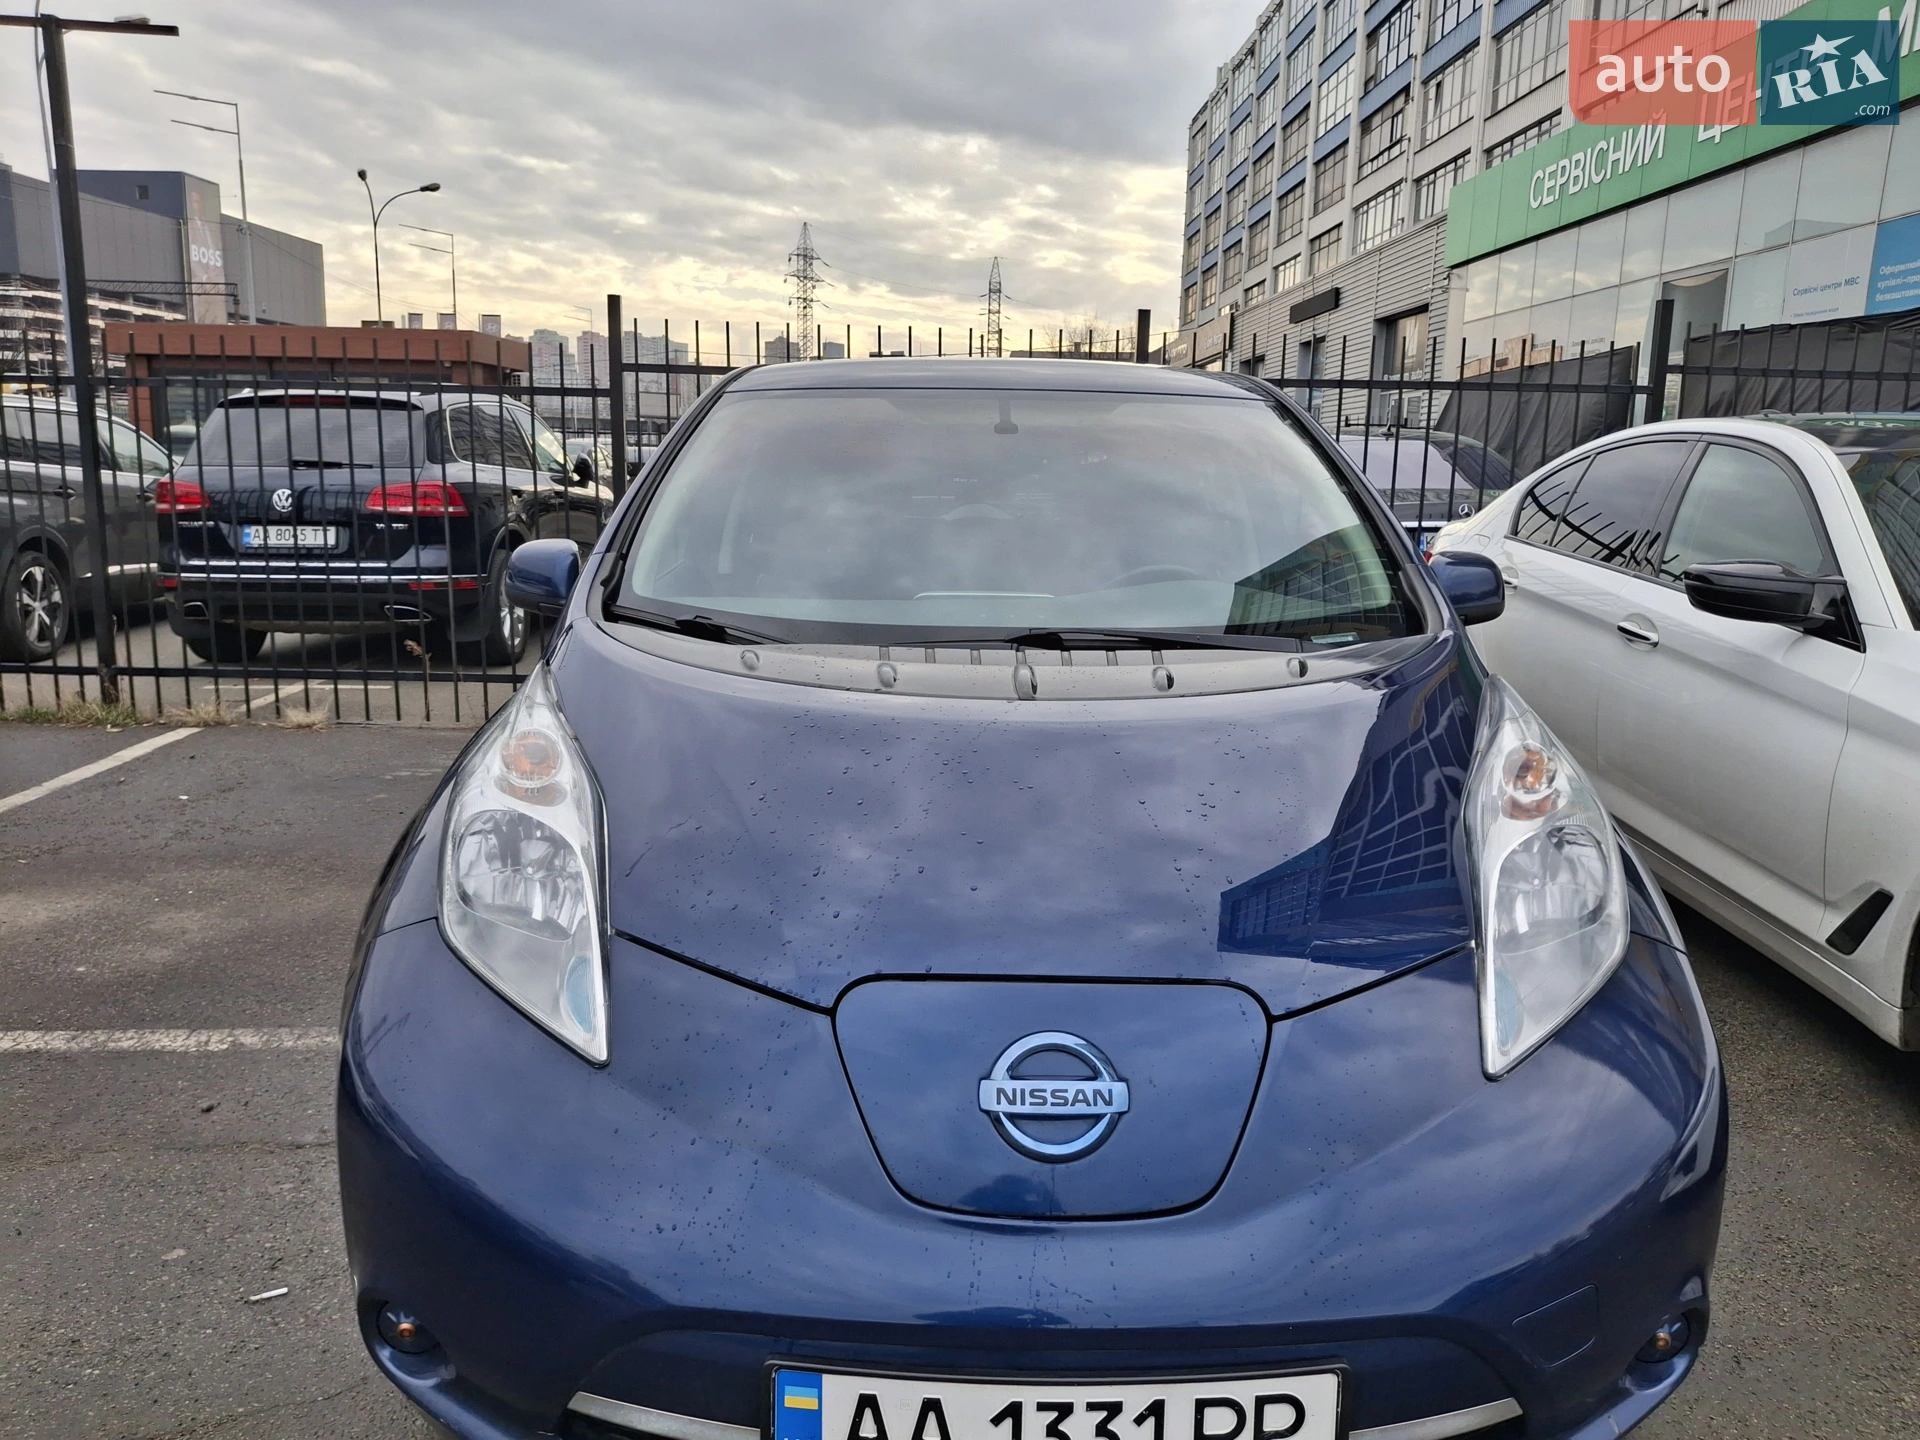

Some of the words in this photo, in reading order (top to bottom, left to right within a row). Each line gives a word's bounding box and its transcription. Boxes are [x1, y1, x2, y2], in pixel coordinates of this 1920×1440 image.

[1529, 108, 1669, 209] СЕРВІСНИЙ
[191, 244, 222, 267] BOSS
[1792, 286, 1819, 297] Сервісні
[1843, 276, 1860, 287] МВС
[996, 1086, 1113, 1107] NISSAN
[847, 1393, 950, 1440] AA
[989, 1399, 1166, 1440] 1331
